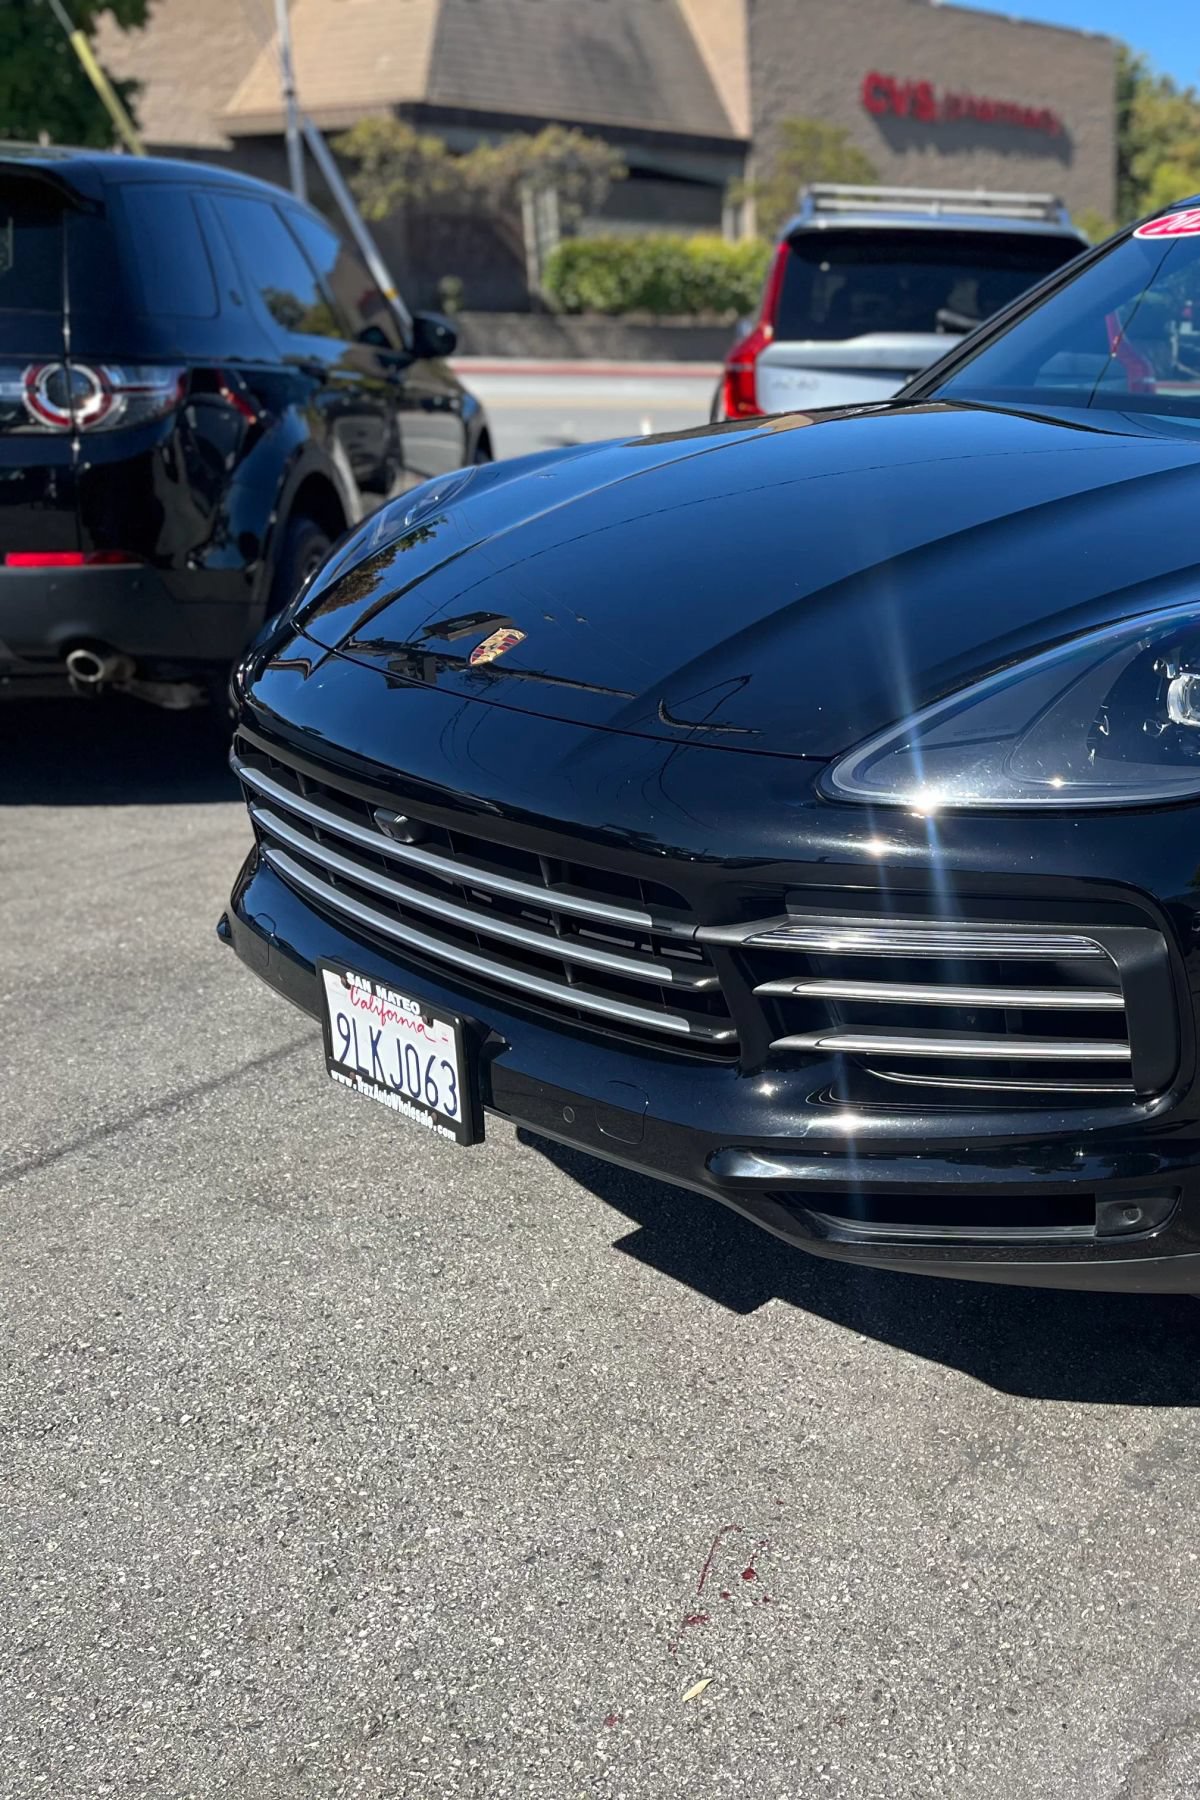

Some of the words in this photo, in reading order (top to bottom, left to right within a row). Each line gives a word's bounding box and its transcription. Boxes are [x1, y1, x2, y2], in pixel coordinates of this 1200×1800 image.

[862, 70, 937, 123] CVS
[345, 971, 371, 995] SAN
[375, 984, 421, 1016] MATEO
[336, 1011, 458, 1117] 9LKJ063
